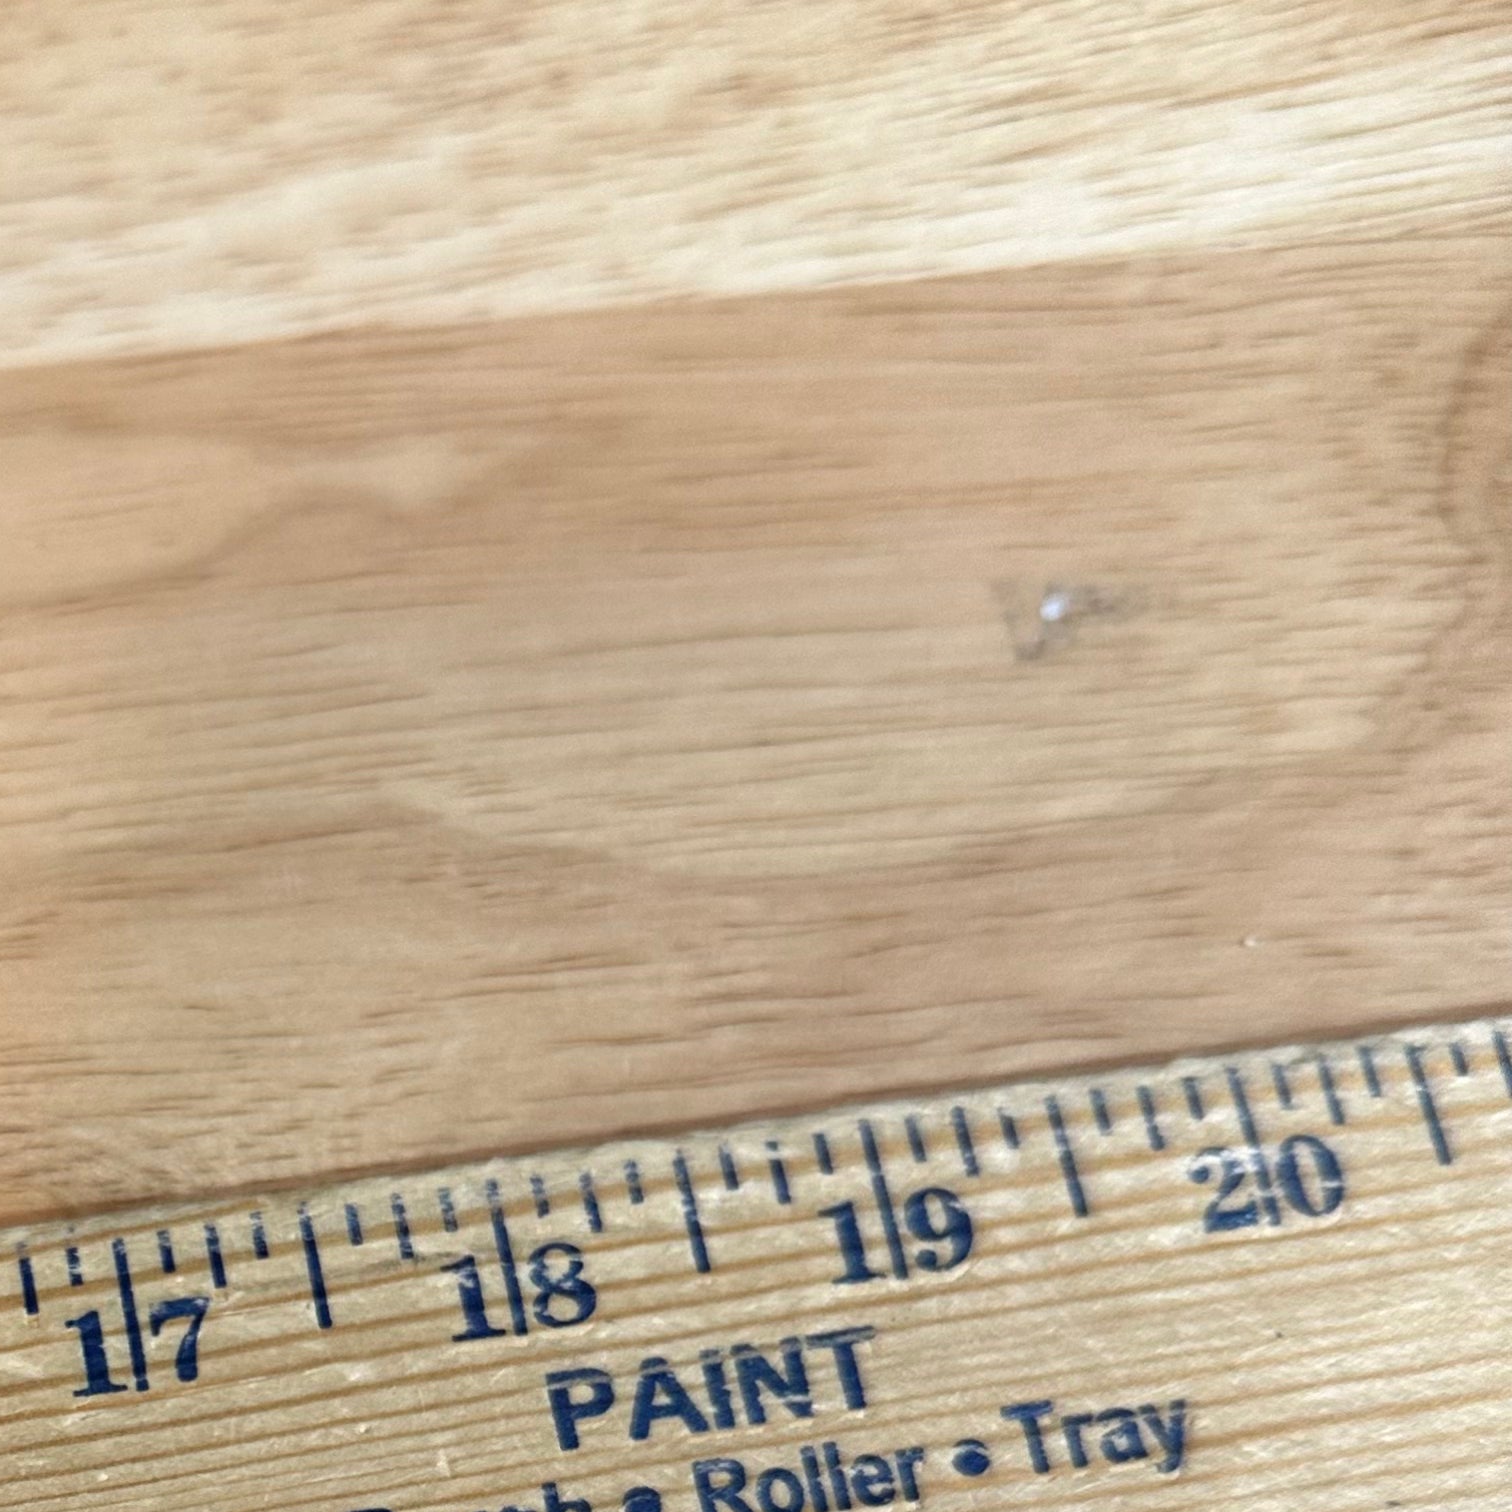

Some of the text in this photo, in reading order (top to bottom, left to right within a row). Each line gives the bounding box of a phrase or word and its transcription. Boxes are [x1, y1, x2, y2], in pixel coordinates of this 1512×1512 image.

[64, 1296, 211, 1397] 17
[440, 1242, 598, 1342] 18
[817, 1187, 975, 1284] 19
[1190, 1134, 1345, 1233] 20
[544, 1326, 877, 1451] PAINT
[1000, 1399, 1187, 1474] Tray
